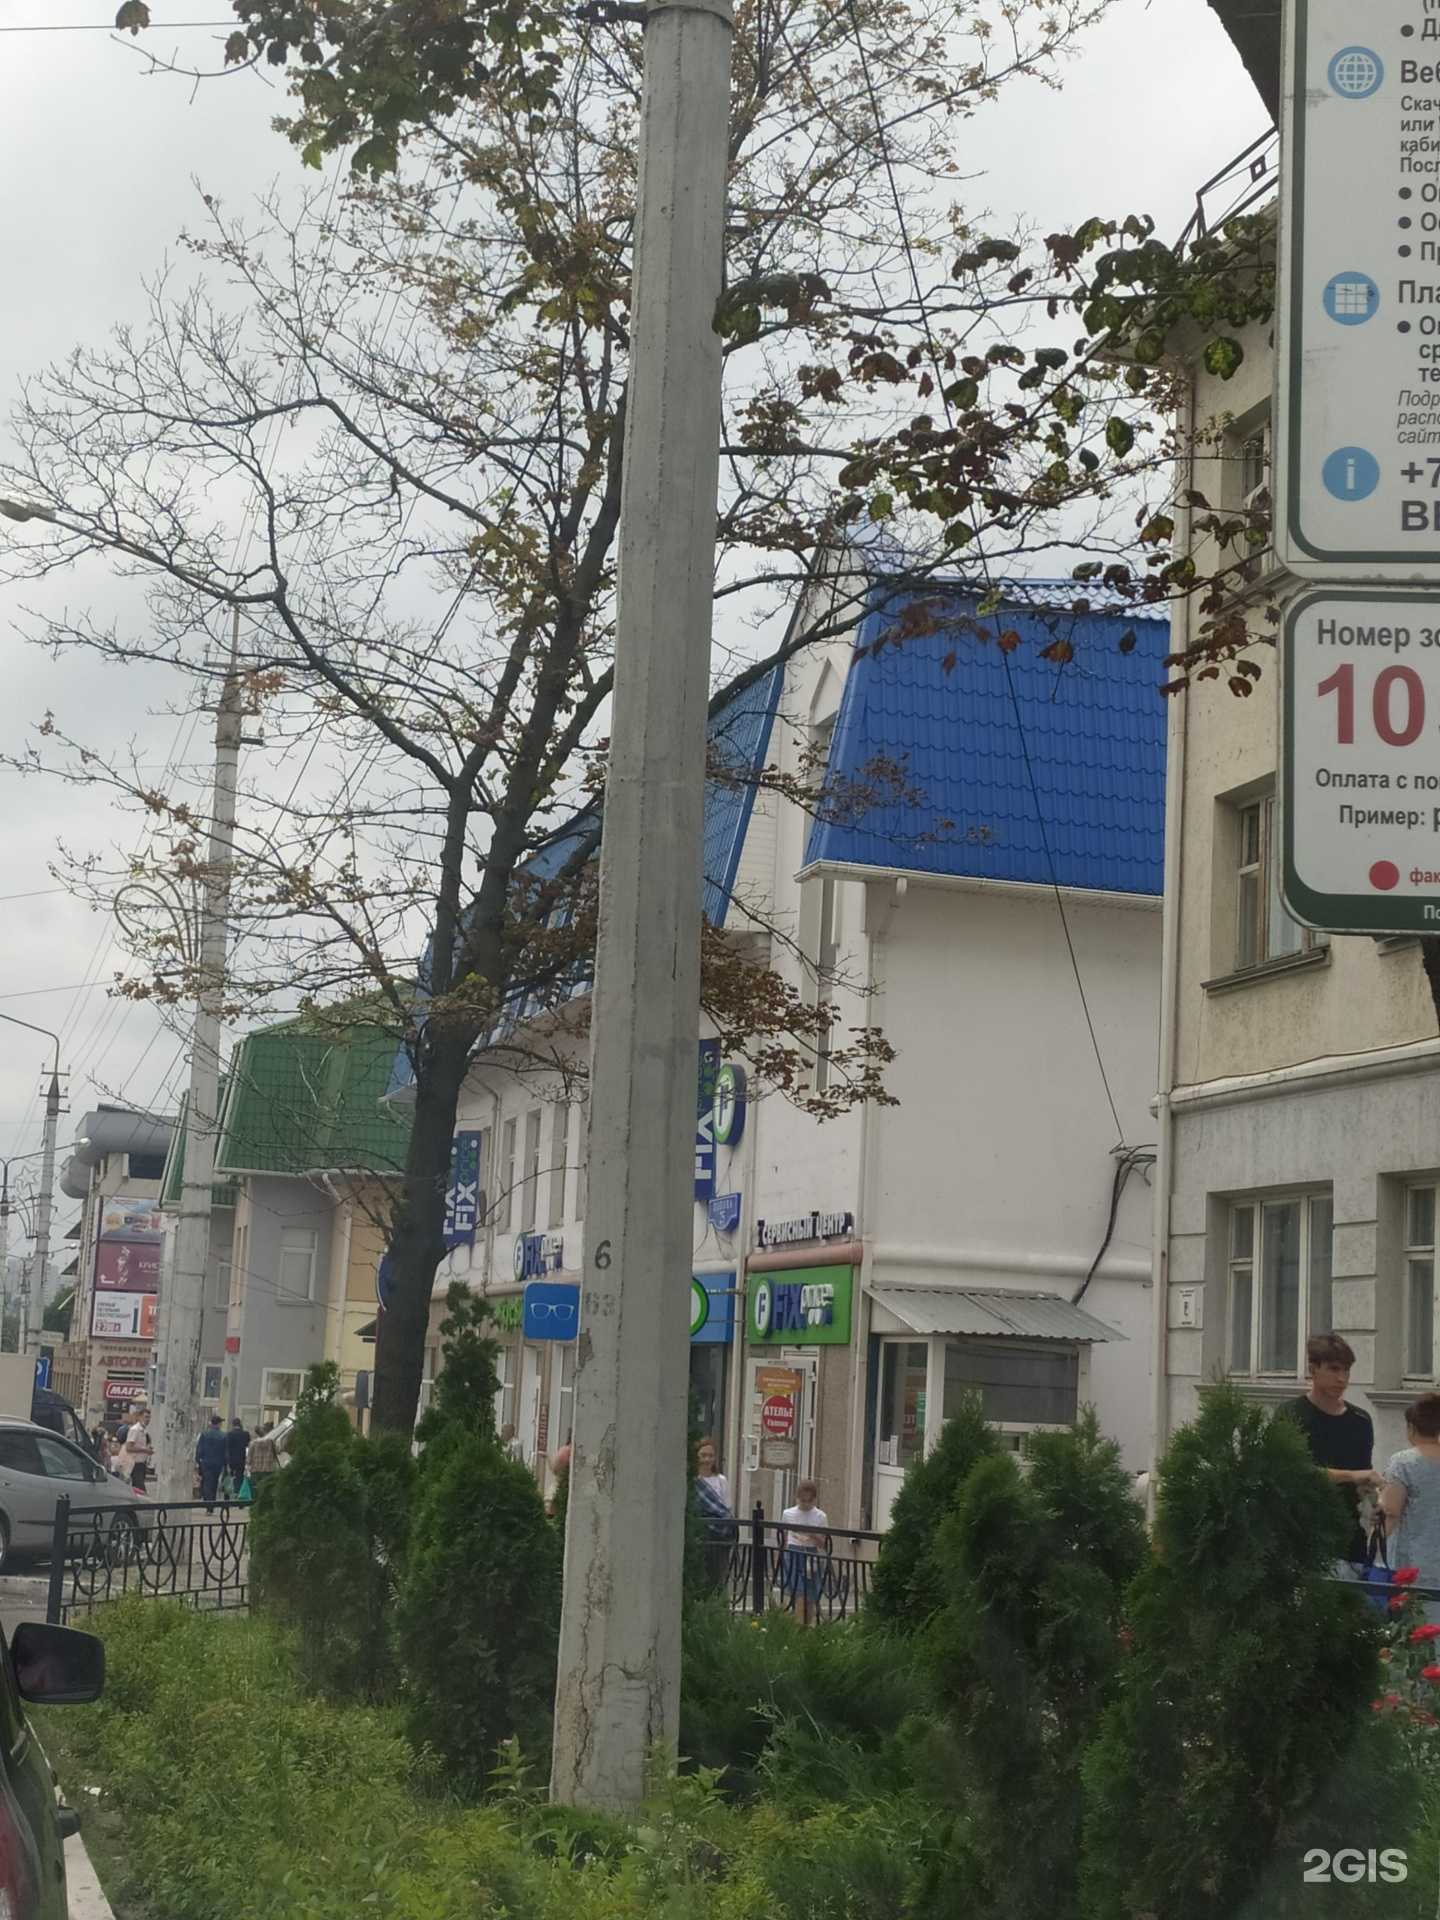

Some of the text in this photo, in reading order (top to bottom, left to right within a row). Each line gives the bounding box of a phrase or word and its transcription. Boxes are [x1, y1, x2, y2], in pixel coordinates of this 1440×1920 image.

[1401, 119, 1434, 132] или
[1317, 619, 1410, 653] Номер
[1318, 664, 1425, 747] 10
[1316, 768, 1440, 790] Оплата с по
[1340, 804, 1425, 830] Пример:
[455, 1181, 477, 1231] FIX
[595, 1240, 611, 1270] 6
